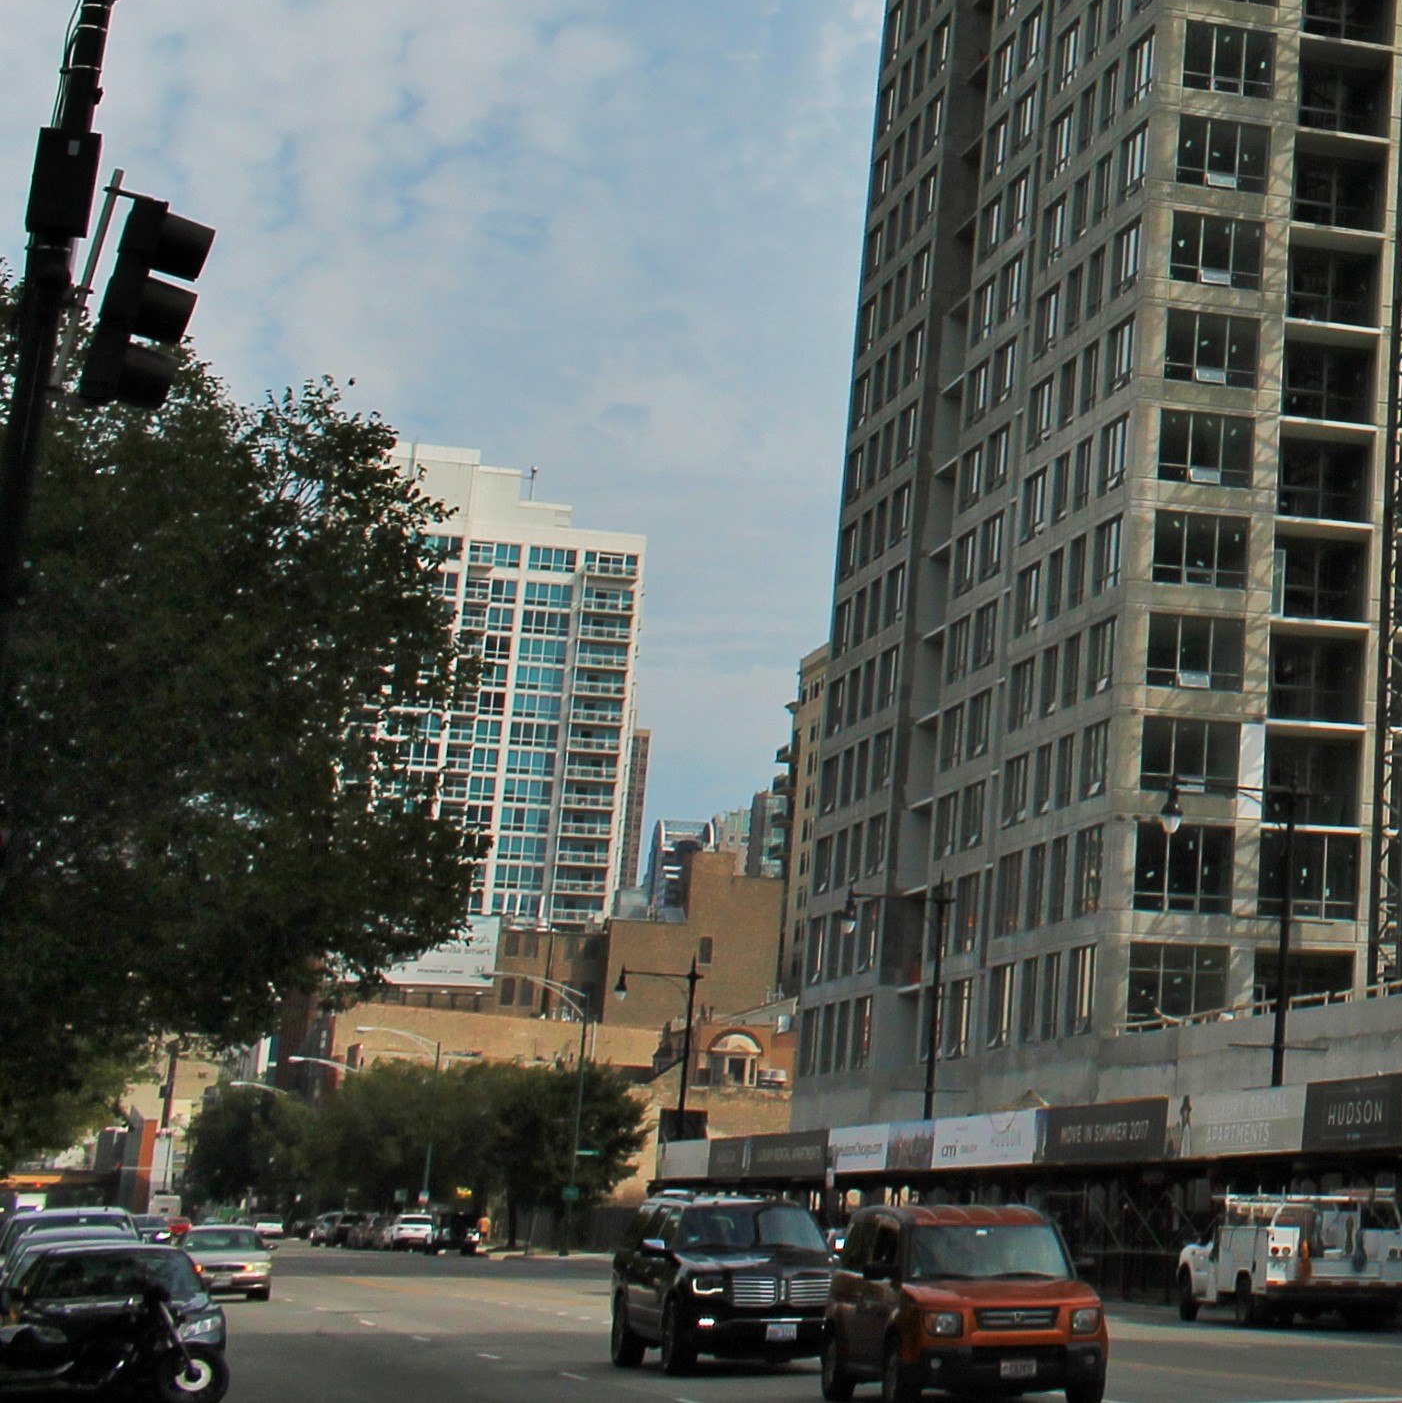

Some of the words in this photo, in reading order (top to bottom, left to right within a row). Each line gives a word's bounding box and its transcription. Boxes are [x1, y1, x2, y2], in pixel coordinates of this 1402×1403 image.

[1327, 1099, 1383, 1125] HUDSON
[1061, 1125, 1082, 1143] MOVE
[1083, 1124, 1092, 1142] IN
[1095, 1122, 1127, 1142] SUMMER
[1129, 1119, 1149, 1140] 2017
[1206, 1121, 1270, 1143] APARTMENTS
